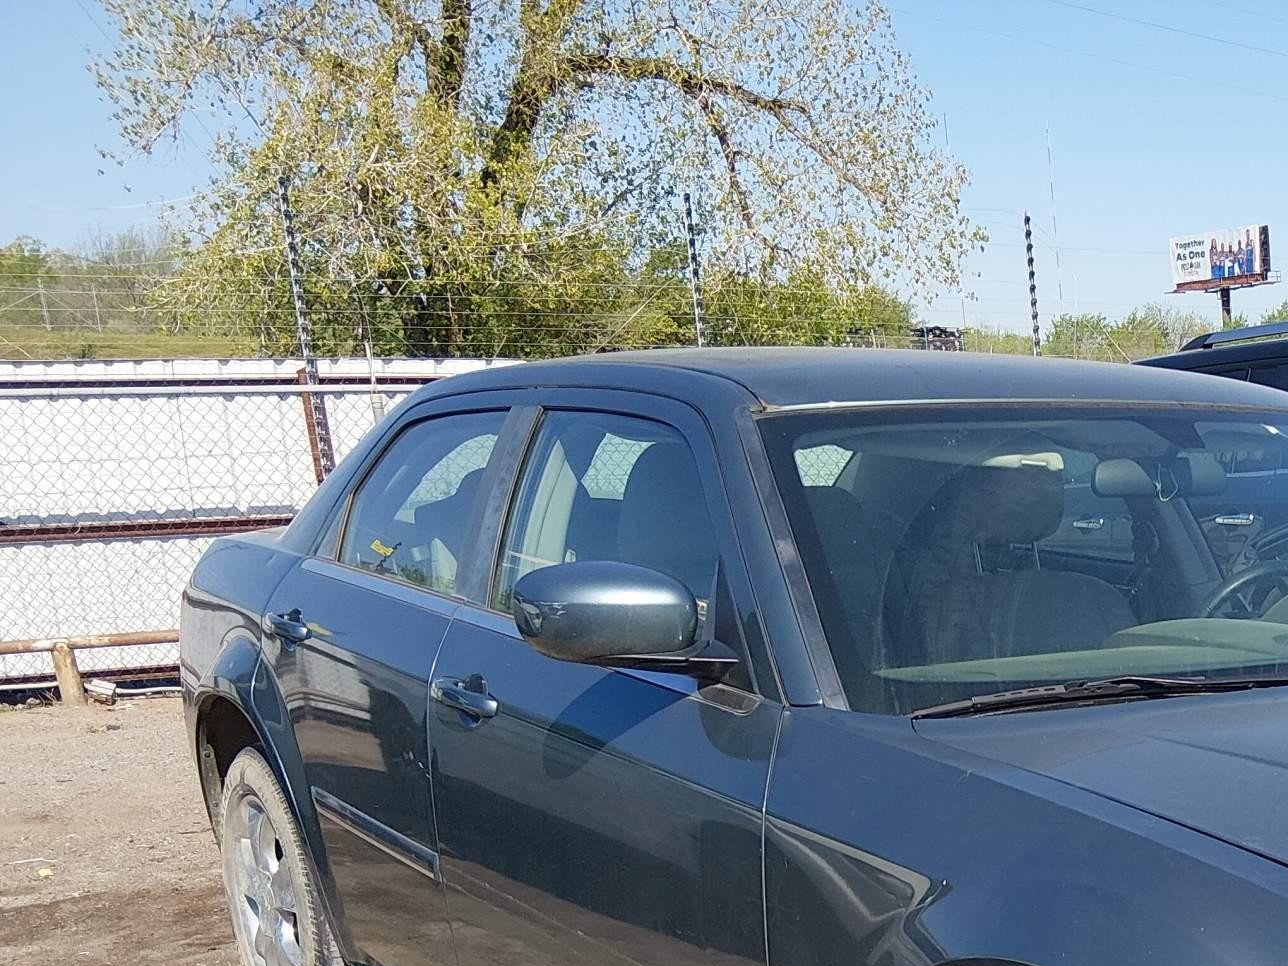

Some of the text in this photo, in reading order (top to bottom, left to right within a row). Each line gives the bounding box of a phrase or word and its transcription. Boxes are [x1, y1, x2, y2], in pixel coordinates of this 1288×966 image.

[1175, 240, 1204, 250] Together
[1176, 251, 1205, 261] As One
